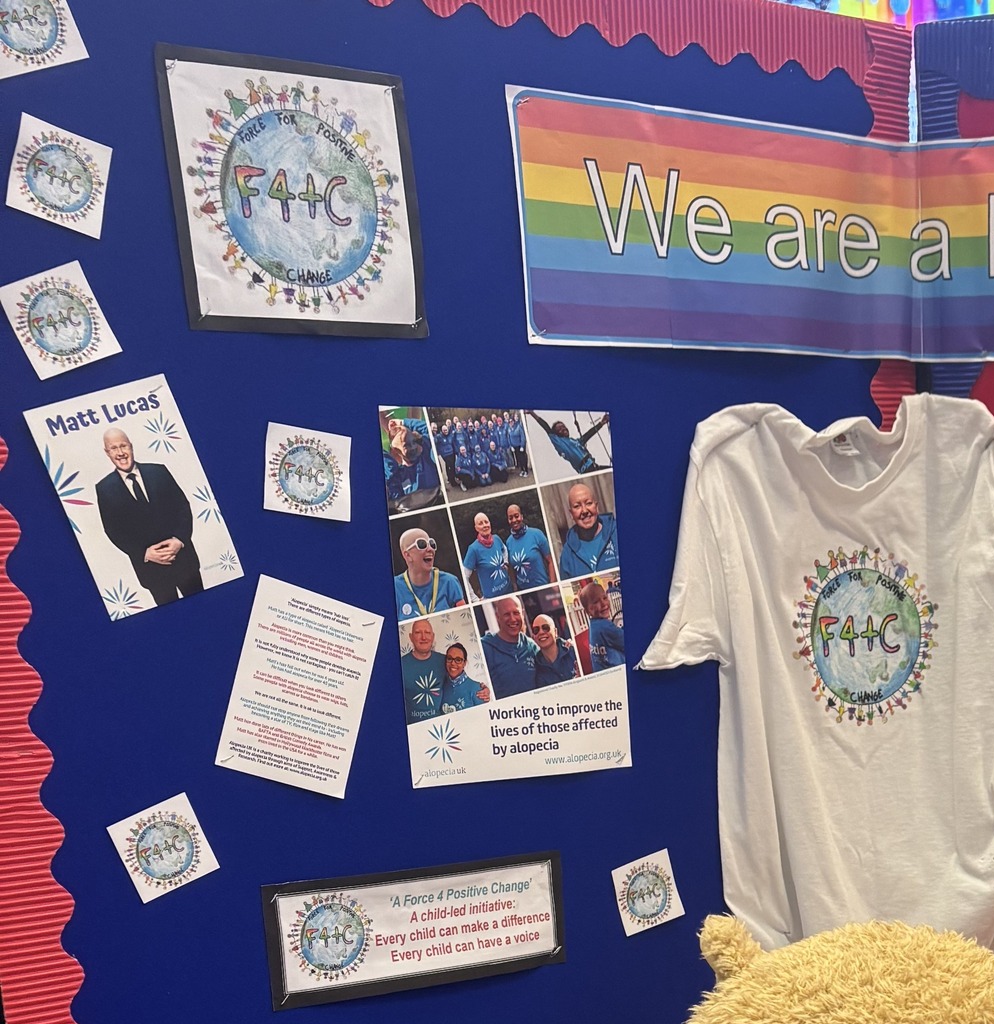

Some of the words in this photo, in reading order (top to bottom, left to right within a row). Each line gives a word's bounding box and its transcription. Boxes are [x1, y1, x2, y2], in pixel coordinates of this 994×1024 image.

[239, 119, 266, 144] FORCE
[276, 114, 296, 126] FOR
[316, 124, 356, 162] POSITIVE
[234, 165, 352, 227] F4+C
[584, 158, 733, 264] We
[764, 203, 880, 279] are
[910, 217, 953, 283] a
[286, 268, 332, 284] CHANGE
[45, 408, 100, 436] Matt
[101, 393, 160, 423] Lucas
[822, 578, 841, 600] FORCE
[848, 571, 862, 582] FOR
[819, 614, 901, 657] F4+C
[851, 689, 883, 703] CHANGE
[489, 708, 540, 722] Working
[542, 706, 554, 716] to
[557, 703, 602, 719] improve
[604, 700, 623, 711] the
[491, 725, 519, 738] lives
[522, 723, 536, 735] of
[538, 720, 570, 734] those
[572, 717, 618, 731] affected
[493, 742, 507, 757] by
[510, 739, 559, 756] alopecia
[545, 750, 622, 765] www.alopecia.org.uk
[424, 769, 455, 779] alopecia
[404, 894, 434, 907] Force
[437, 892, 444, 902] 4
[446, 886, 488, 900] Positive
[410, 912, 418, 923] A
[421, 905, 466, 922] child-led
[469, 899, 516, 914] initiative:
[305, 924, 354, 950] F4+C
[375, 932, 406, 947] Every
[410, 929, 435, 942] child
[439, 926, 458, 938] can
[461, 920, 490, 935] make
[492, 921, 499, 930] a
[501, 912, 551, 930] difference
[391, 948, 422, 963] Every
[426, 944, 452, 957] child
[455, 941, 475, 953] can
[478, 937, 503, 950] have
[505, 936, 512, 945] a
[514, 931, 540, 943] voice
